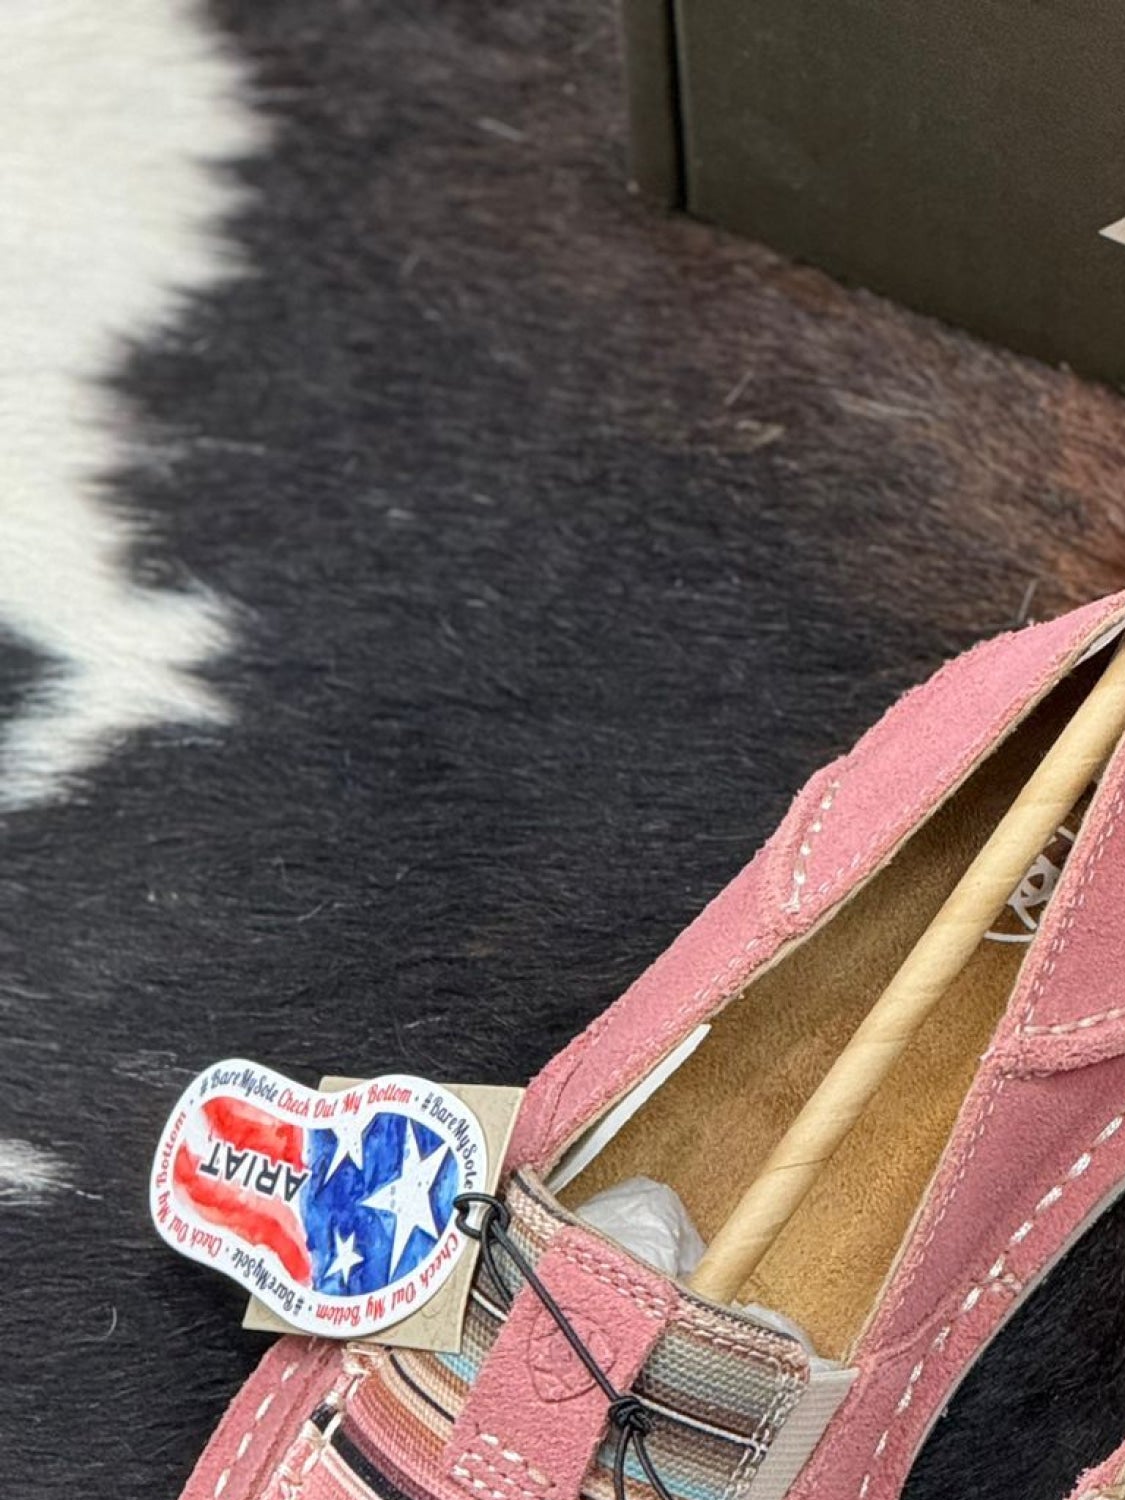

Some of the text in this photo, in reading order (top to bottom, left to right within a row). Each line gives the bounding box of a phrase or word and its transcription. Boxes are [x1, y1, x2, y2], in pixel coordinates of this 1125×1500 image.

[277, 1087, 310, 1118] Check
[313, 1098, 338, 1119] Out
[342, 1091, 363, 1115] My
[367, 1083, 413, 1106] Bottom
[155, 1111, 187, 1188] Bottom
[200, 1142, 309, 1203] ARIAT
[156, 1190, 171, 1223] My
[315, 1092, 478, 1327] #BareMySole Check Out My Bottom
[167, 1215, 191, 1244] Out
[190, 1224, 224, 1259] Check
